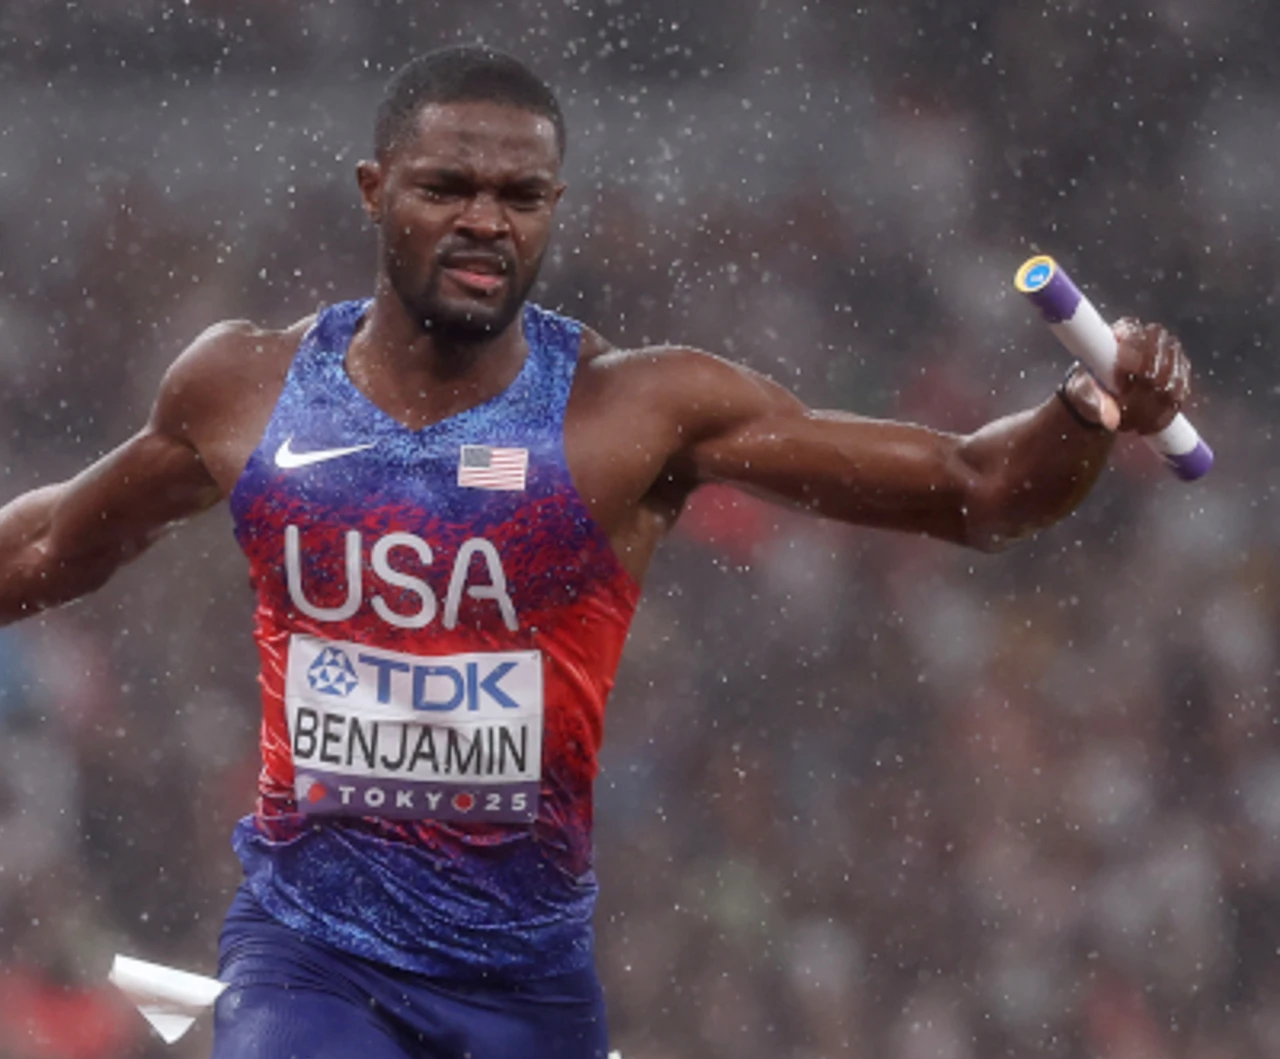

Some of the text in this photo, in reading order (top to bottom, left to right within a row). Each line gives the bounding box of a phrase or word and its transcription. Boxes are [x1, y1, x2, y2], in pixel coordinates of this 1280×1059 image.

[284, 523, 520, 631] USA
[357, 650, 520, 712] TDK
[293, 706, 528, 775] BENJAMIN
